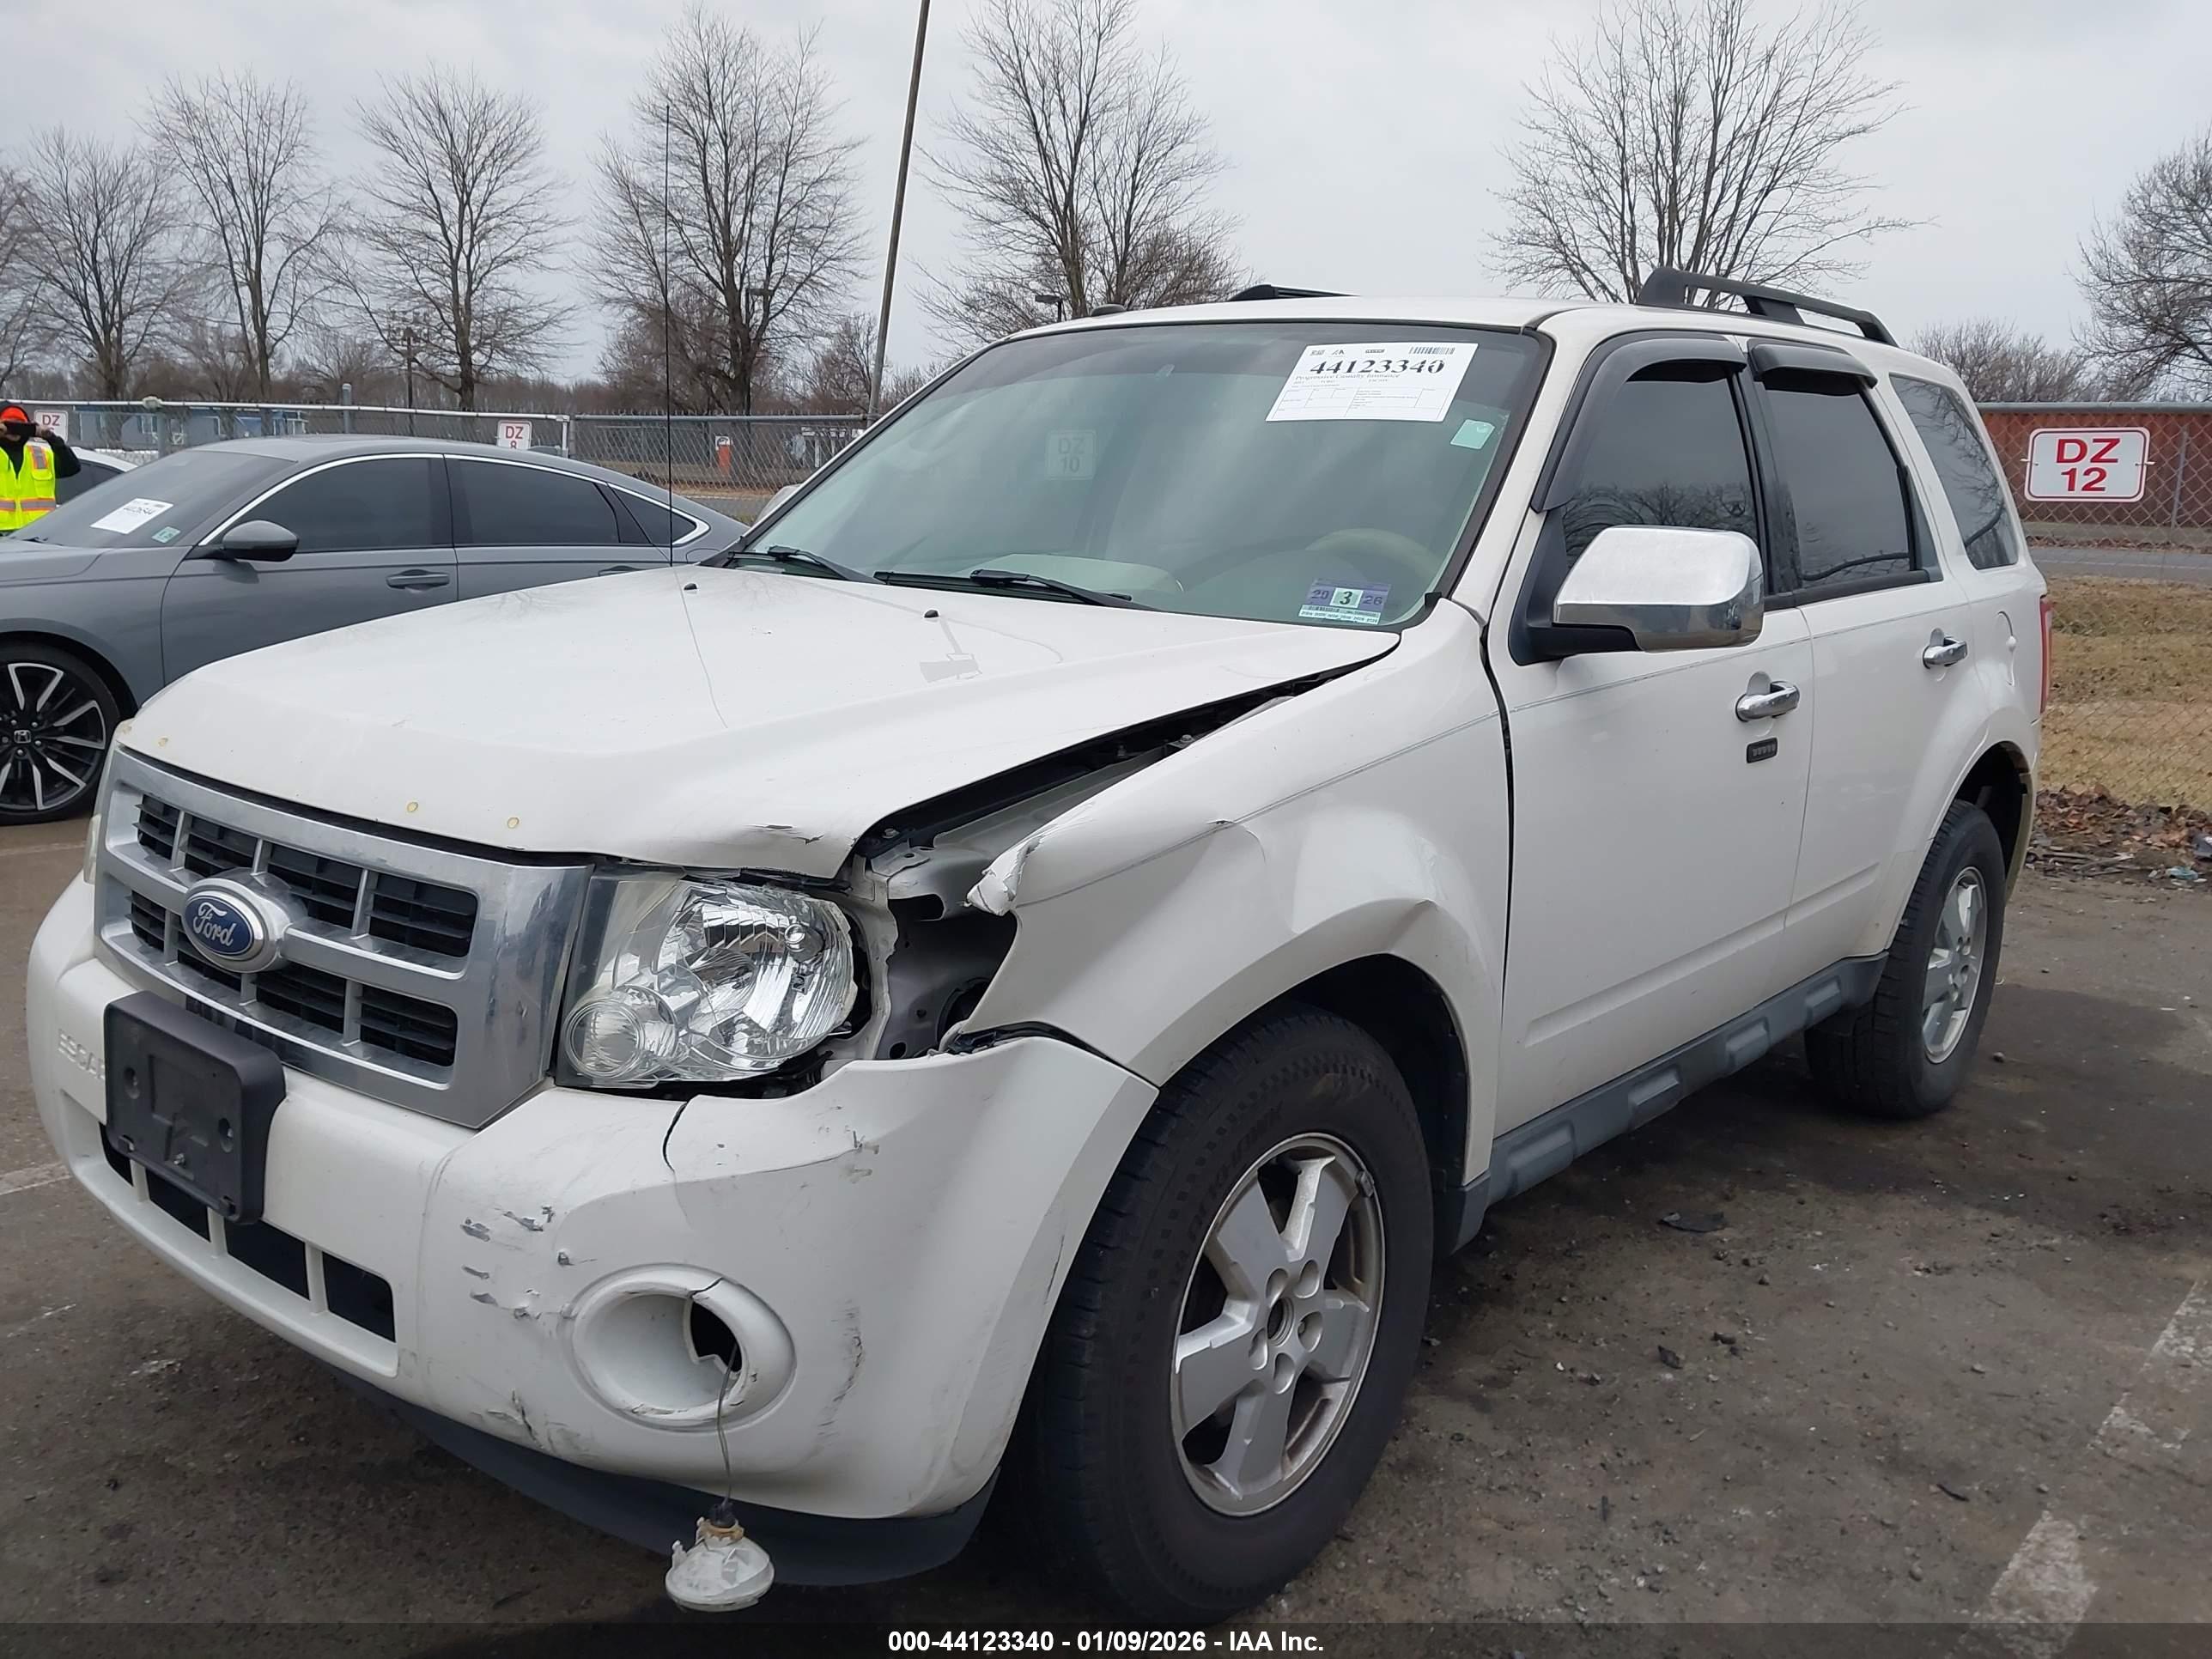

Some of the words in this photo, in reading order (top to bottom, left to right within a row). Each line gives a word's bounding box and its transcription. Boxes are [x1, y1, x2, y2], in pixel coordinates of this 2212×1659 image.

[1310, 359, 1445, 374] 44123340
[43, 414, 60, 427] DZ
[506, 425, 524, 439] DZ
[1058, 437, 1085, 454] DZ
[2057, 438, 2120, 464] DZ
[1060, 457, 1080, 473] 10
[2060, 467, 2106, 492] 12
[1311, 589, 1329, 600] 20
[1340, 591, 1353, 605] 3
[1363, 595, 1383, 606] 26
[192, 902, 238, 947] Ford
